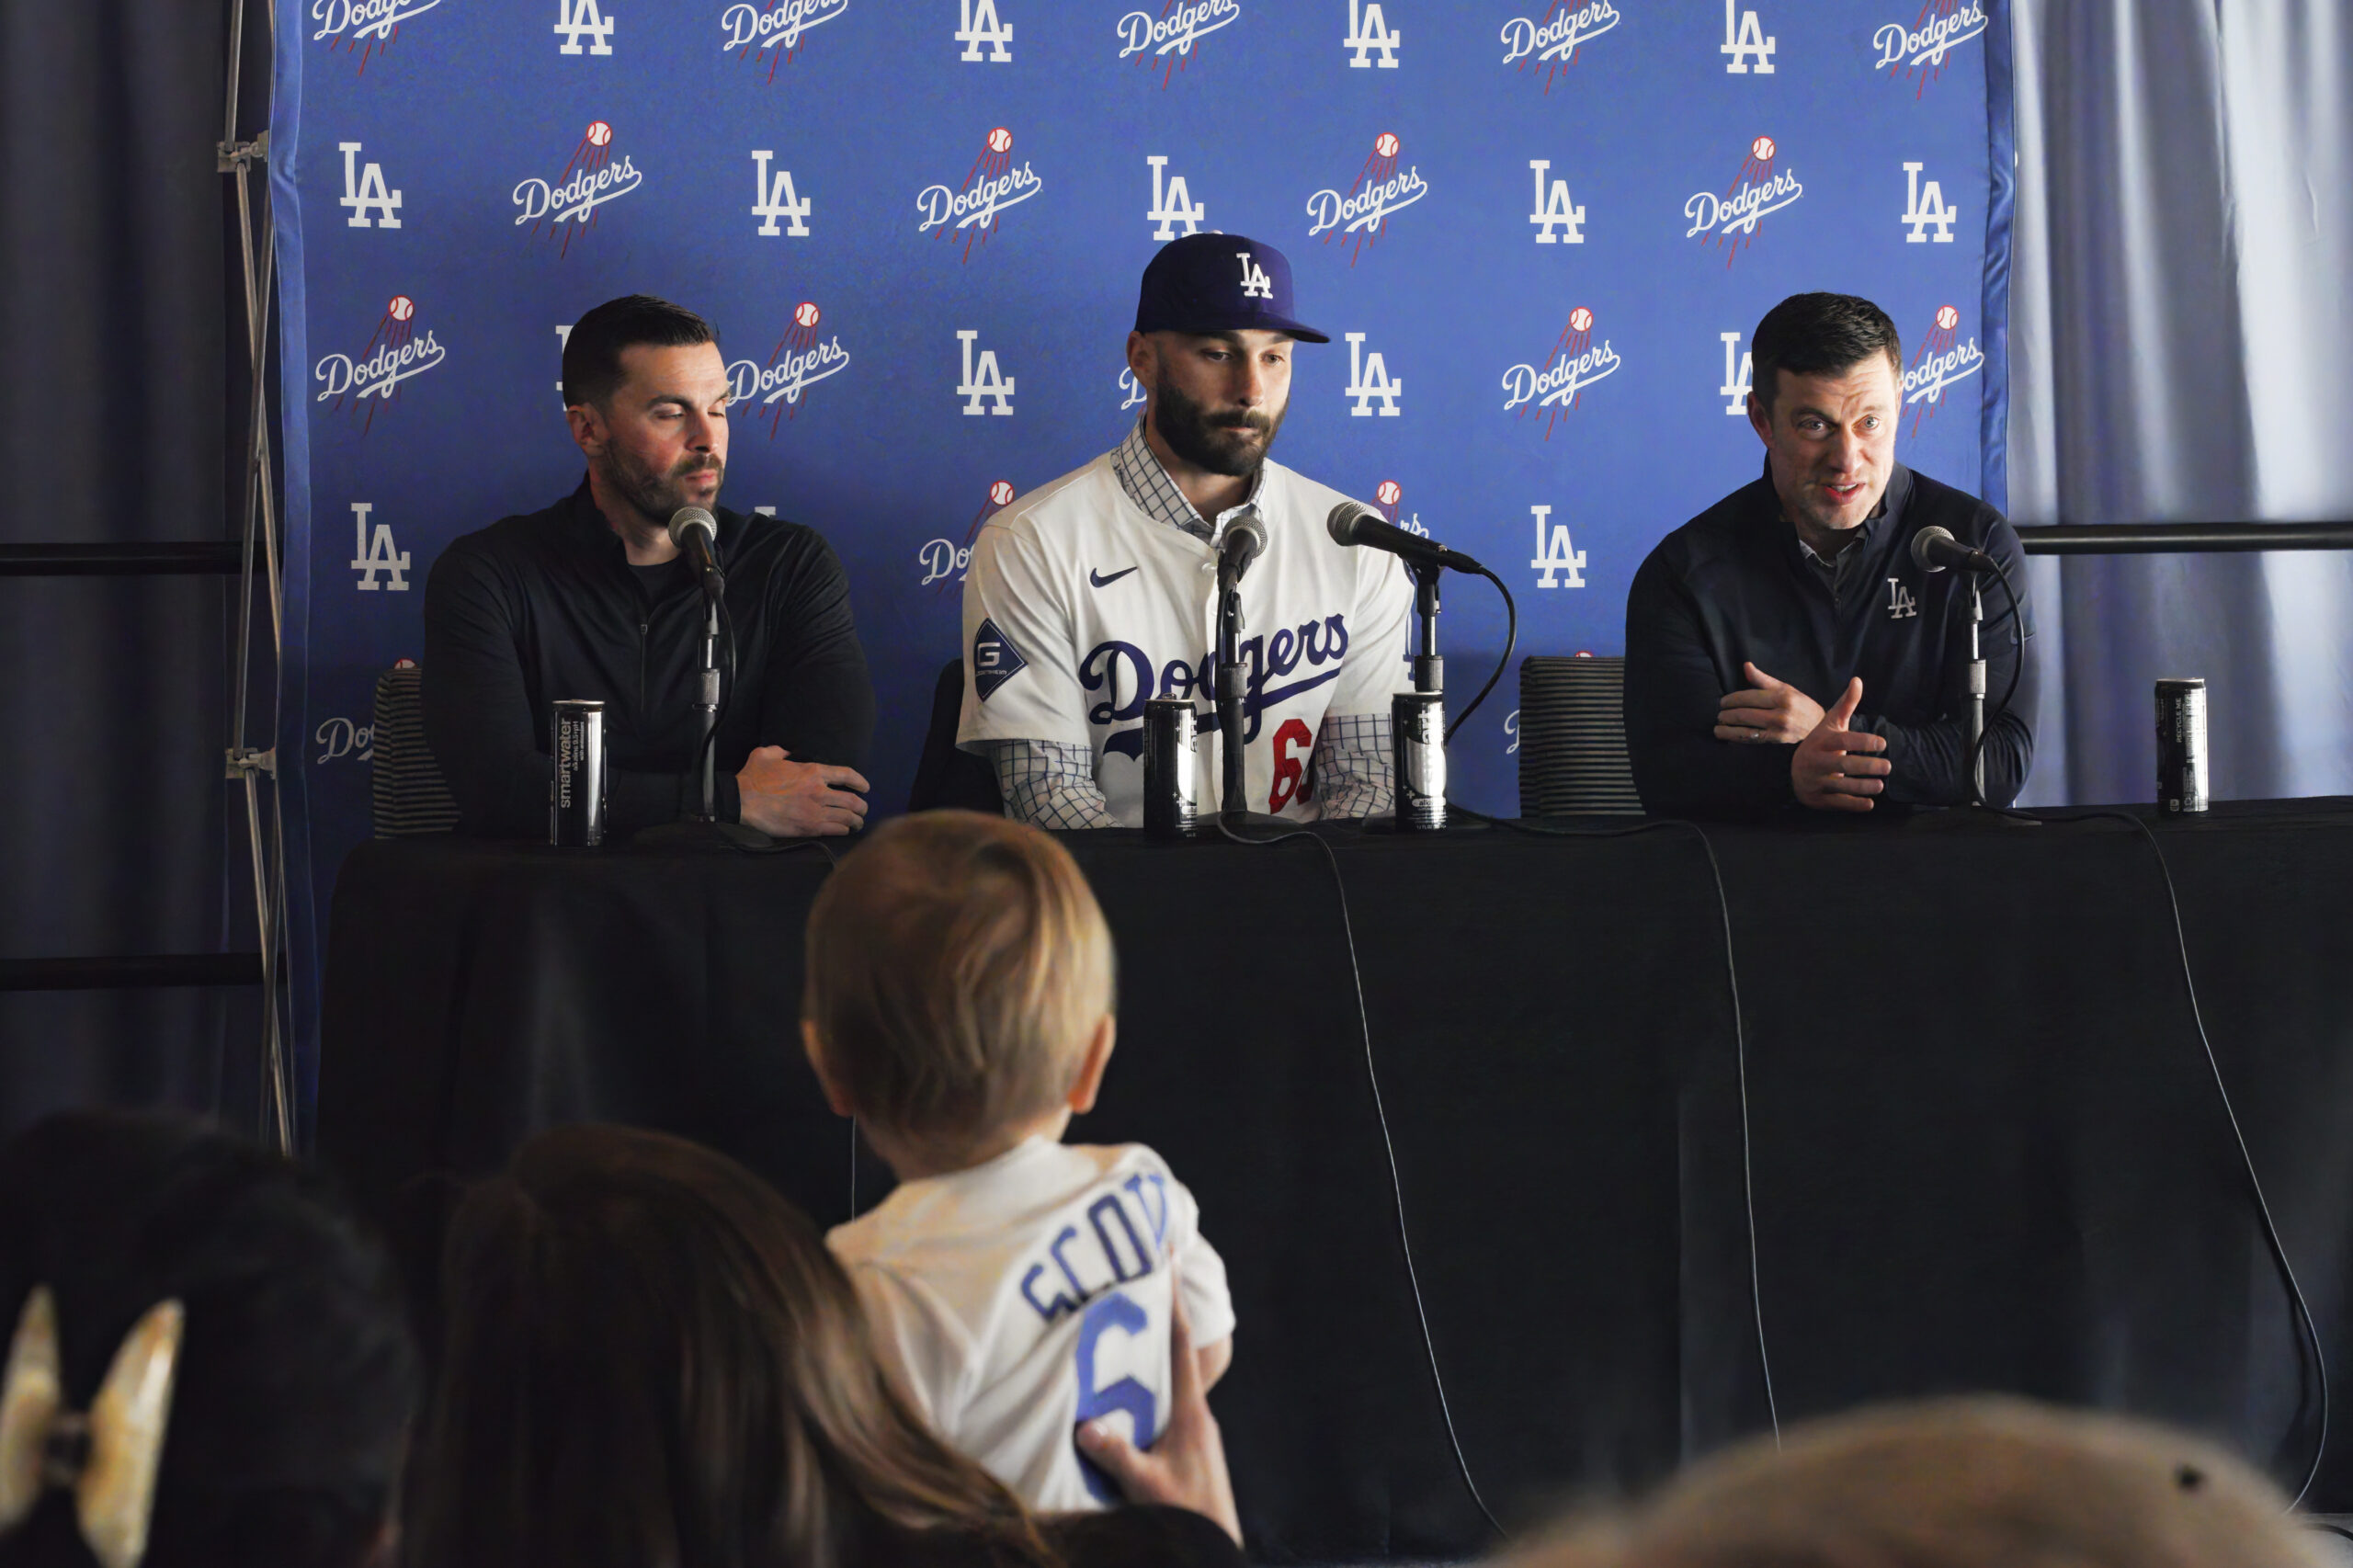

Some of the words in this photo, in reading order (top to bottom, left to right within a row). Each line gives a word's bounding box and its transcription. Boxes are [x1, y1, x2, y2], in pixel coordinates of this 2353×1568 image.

[954, 0, 1013, 62] LA
[1343, 0, 1401, 69] LA
[1500, 0, 1620, 64] Dodgers
[1720, 0, 1776, 74] LA
[1872, 0, 1989, 70] Dodgers
[338, 142, 403, 229] LA
[512, 154, 642, 226] Dodgers
[751, 150, 811, 237] LA
[916, 161, 1042, 233] Dodgers
[1146, 155, 1205, 241] LA
[1306, 165, 1428, 236] Dodgers
[1529, 159, 1586, 244] LA
[1684, 168, 1803, 238] Dodgers
[1901, 162, 1957, 244] LA
[1236, 252, 1274, 300] LA
[315, 330, 446, 403] Dodgers
[725, 335, 850, 407] Dodgers
[956, 330, 1015, 415] LA
[1345, 332, 1402, 417] LA
[1502, 339, 1621, 411] Dodgers
[1904, 336, 1985, 403] odgers
[350, 502, 411, 591] LA
[1530, 505, 1586, 588] LA
[1887, 578, 1917, 619] LA
[561, 718, 572, 809] smartwater
